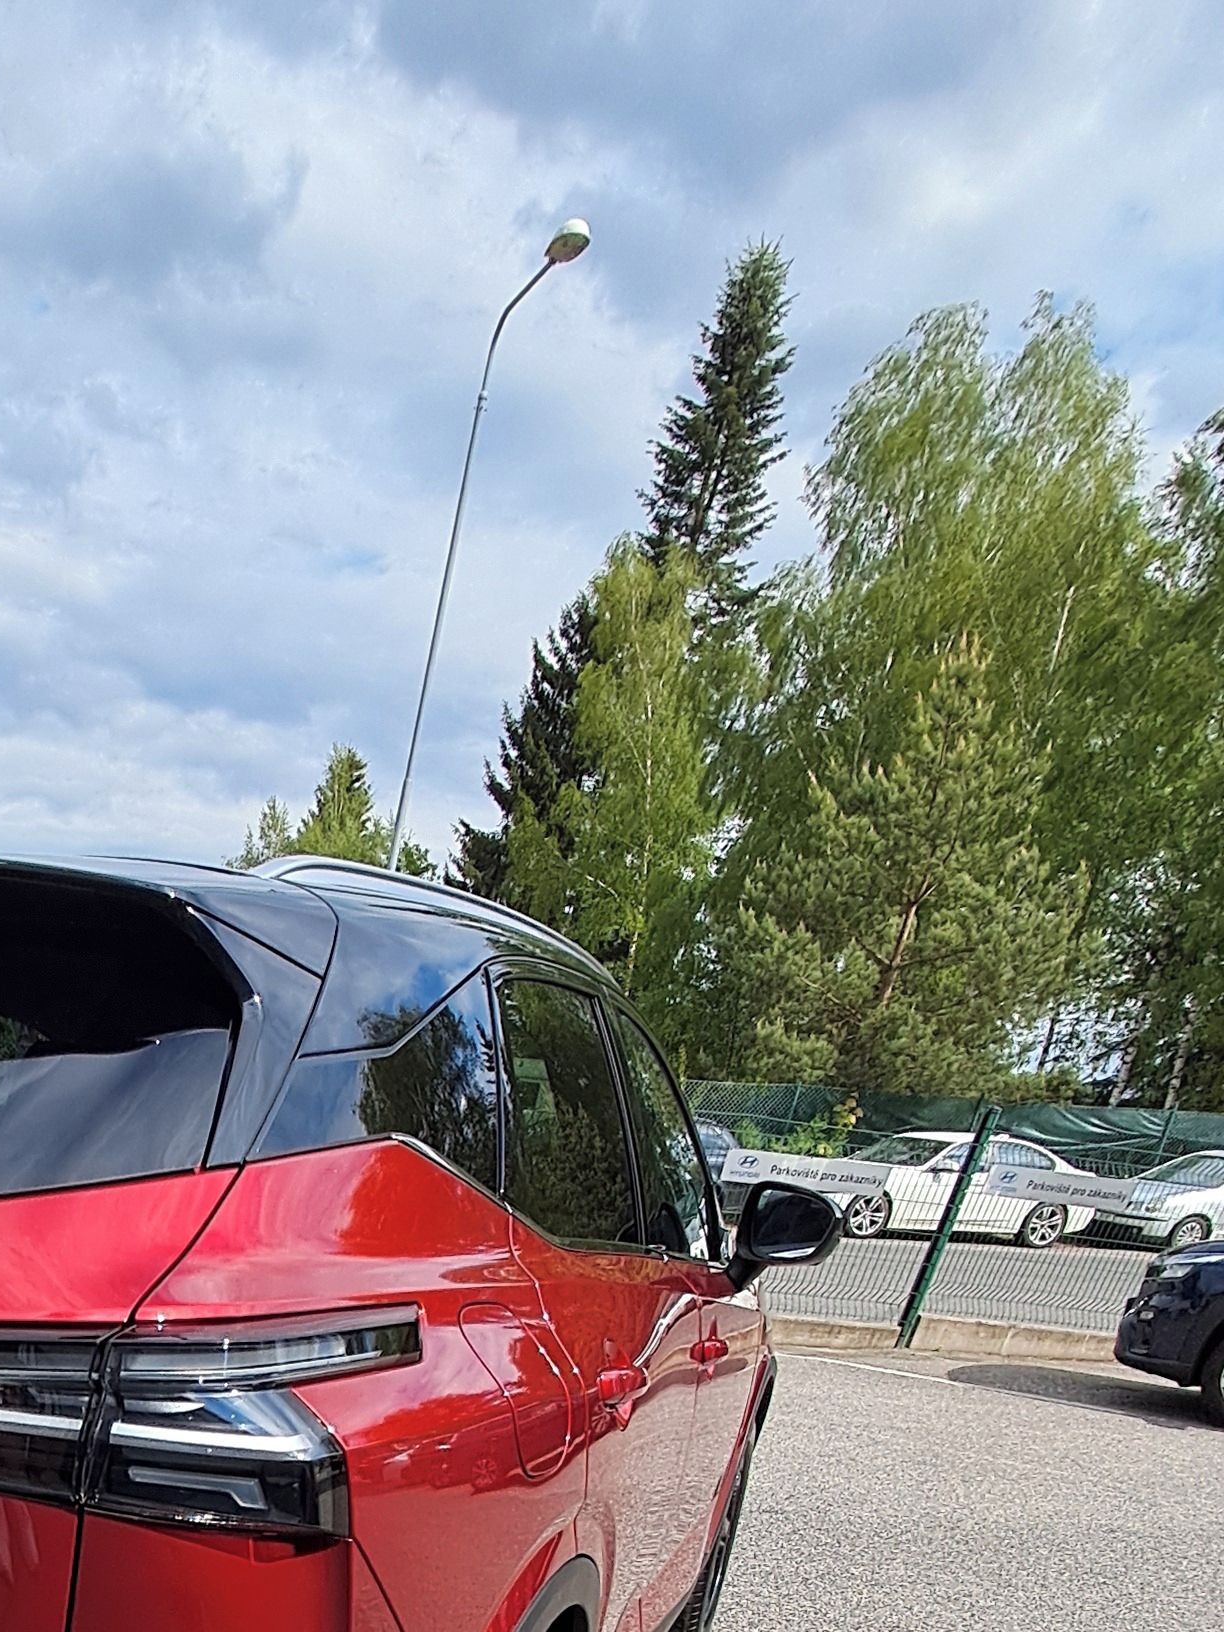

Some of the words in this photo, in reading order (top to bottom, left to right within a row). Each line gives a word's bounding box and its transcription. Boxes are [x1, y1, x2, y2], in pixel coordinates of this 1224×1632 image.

[770, 1164, 819, 1179] Parkoviště
[820, 1172, 837, 1181] pro
[1026, 1180, 1070, 1194] Parkoviště
[1070, 1187, 1086, 1196] pro
